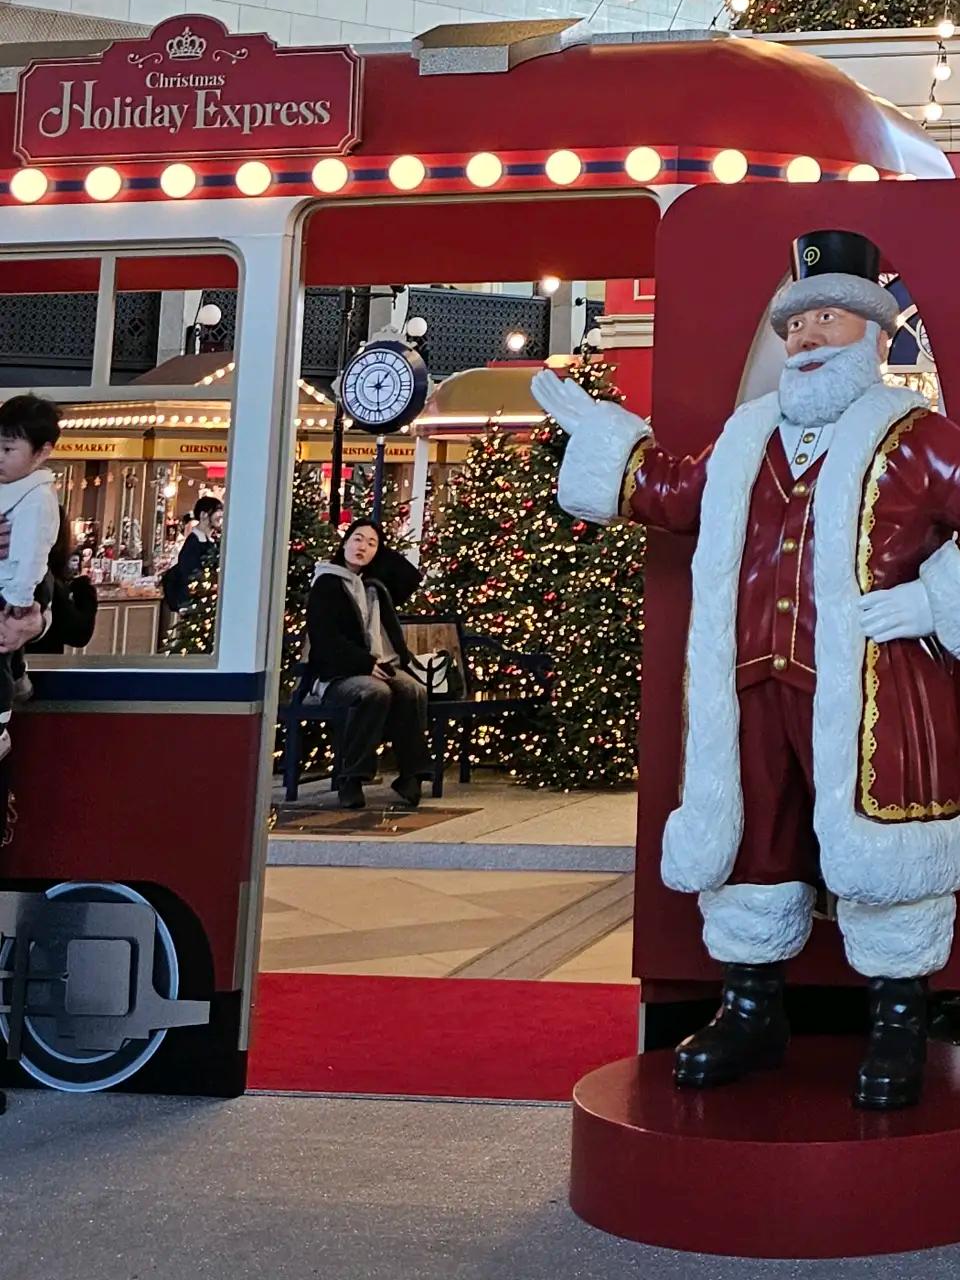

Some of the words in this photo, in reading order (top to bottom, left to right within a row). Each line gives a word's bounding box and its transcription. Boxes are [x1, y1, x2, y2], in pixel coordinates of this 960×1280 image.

[145, 72, 226, 89] Christmas
[39, 80, 189, 138] Holiday
[193, 90, 331, 134] Express
[75, 443, 116, 452] MARKET
[180, 444, 228, 453] CHRISTMA
